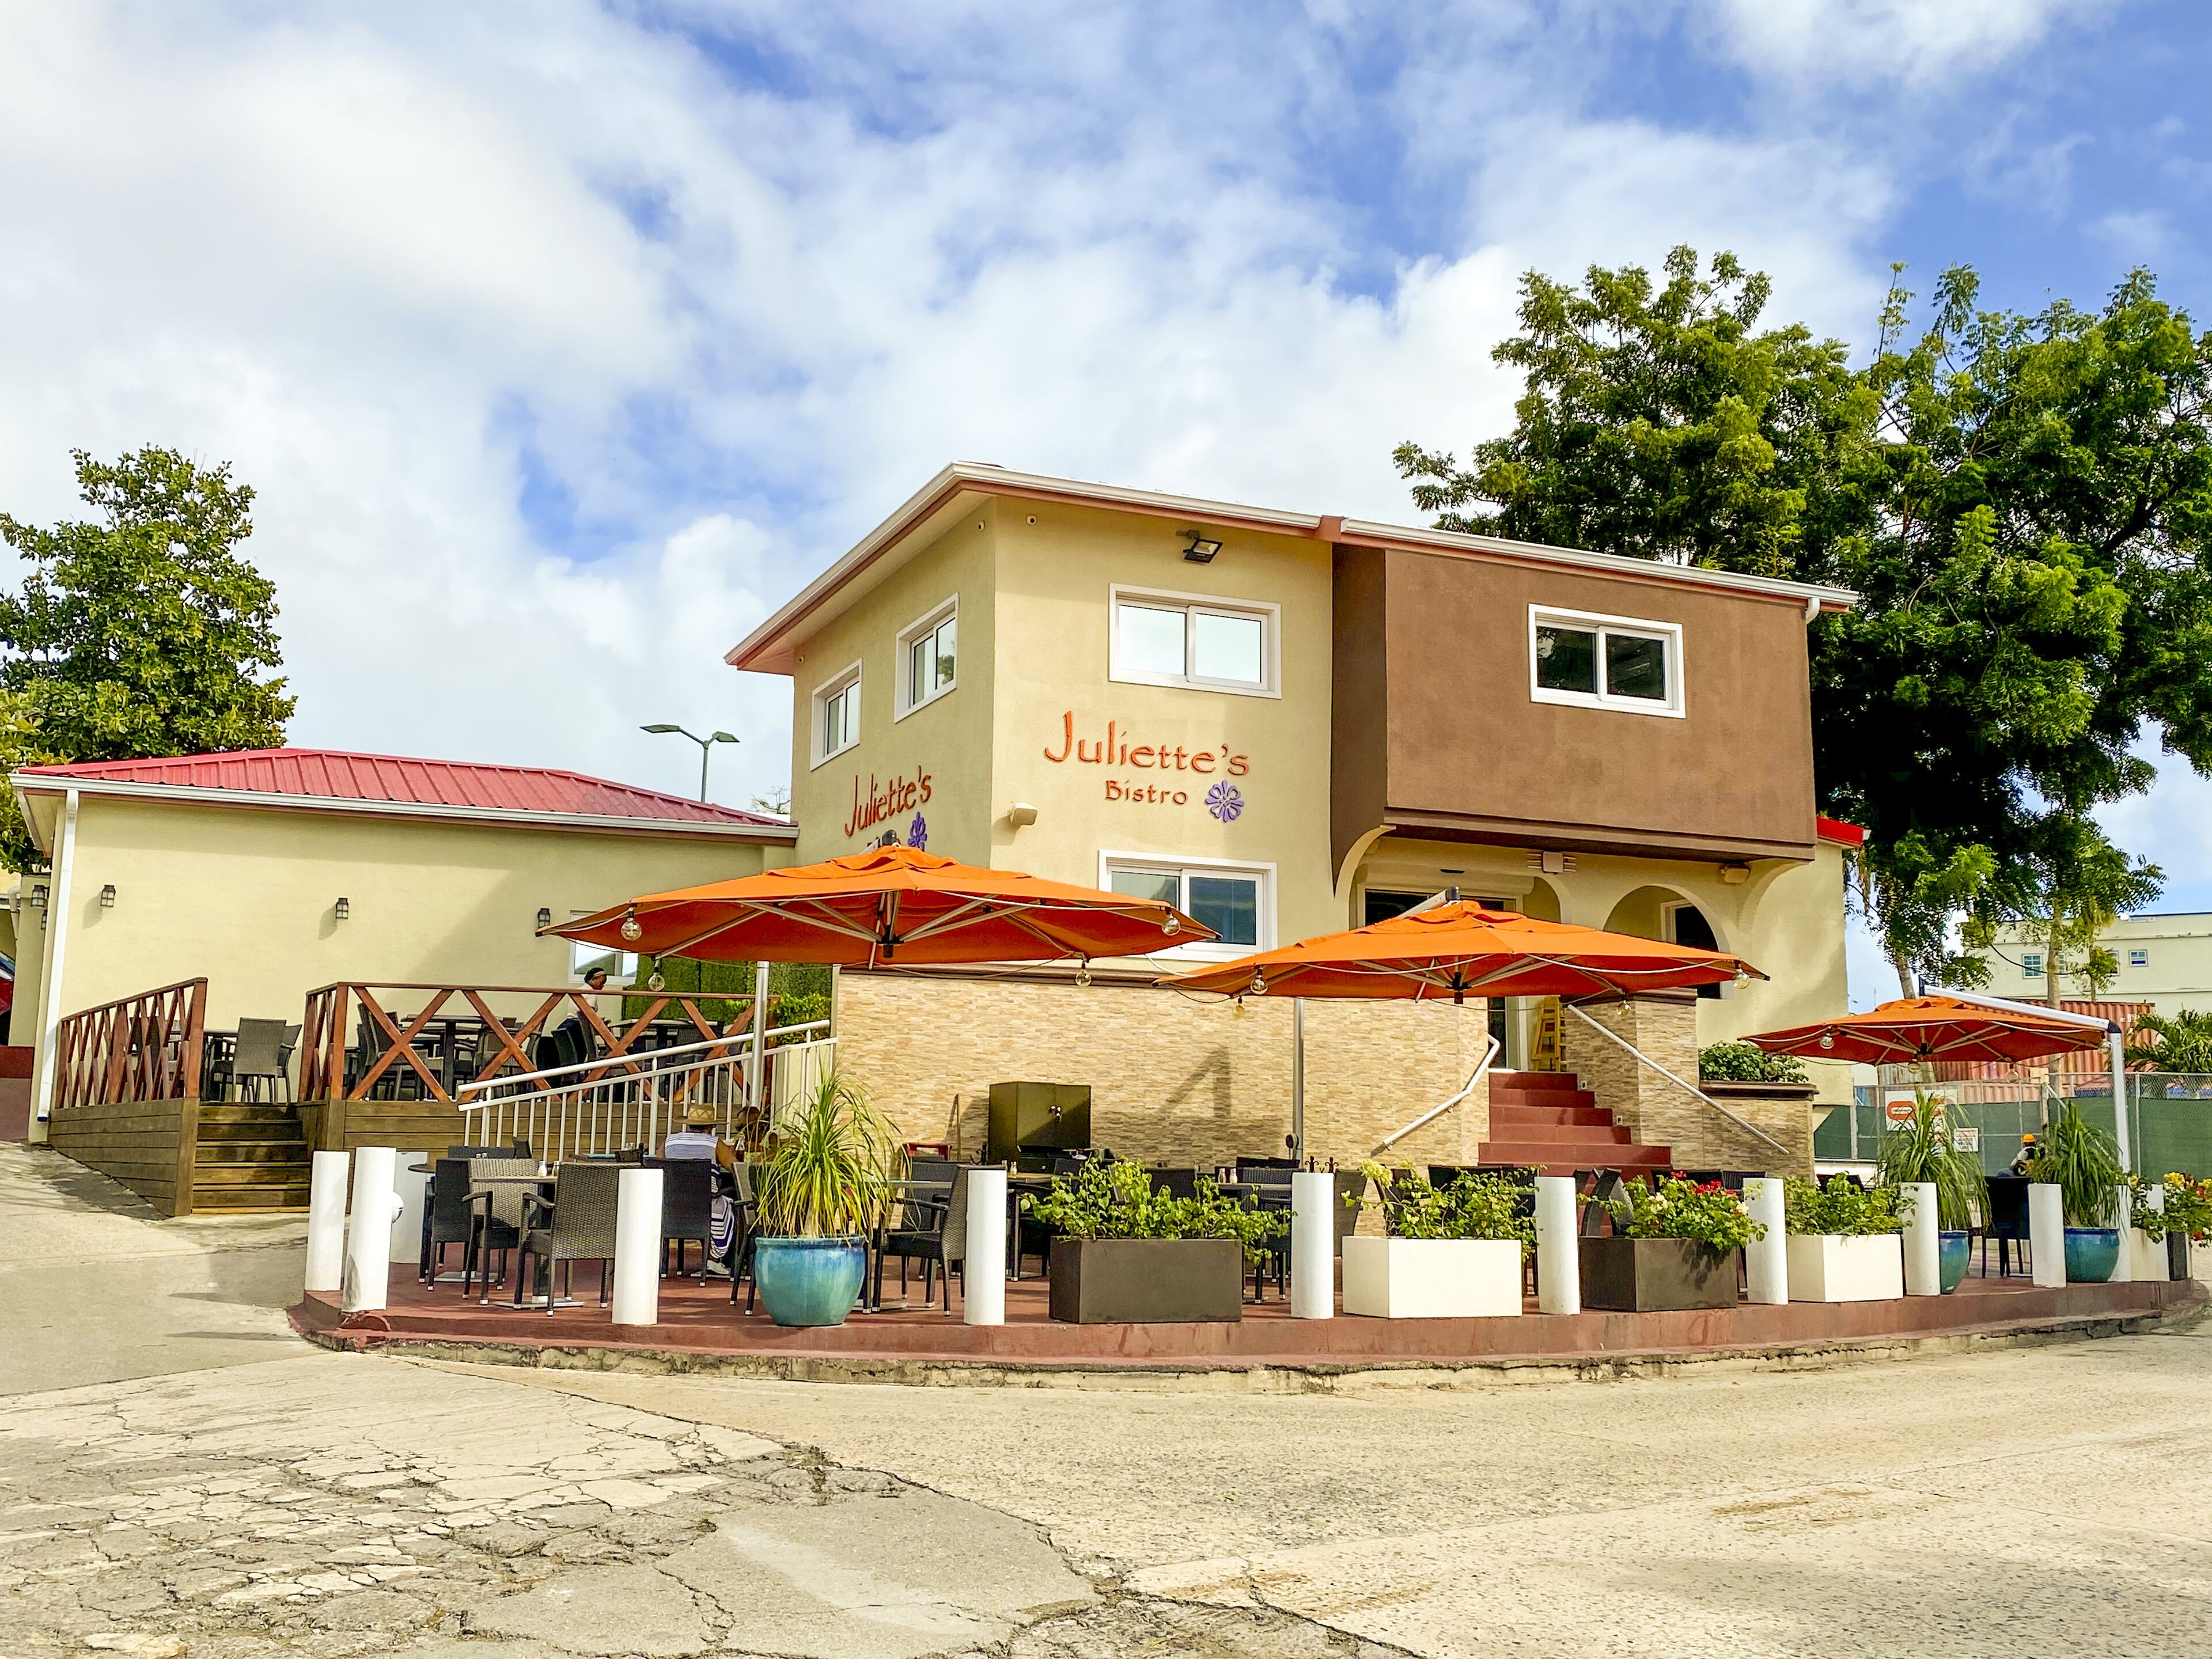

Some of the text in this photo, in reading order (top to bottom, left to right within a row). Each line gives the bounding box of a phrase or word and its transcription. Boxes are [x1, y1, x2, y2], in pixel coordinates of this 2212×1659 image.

[1044, 710, 1250, 775] Juliette's
[844, 765, 931, 836] Juliette's
[1105, 779, 1188, 805] Bistro
